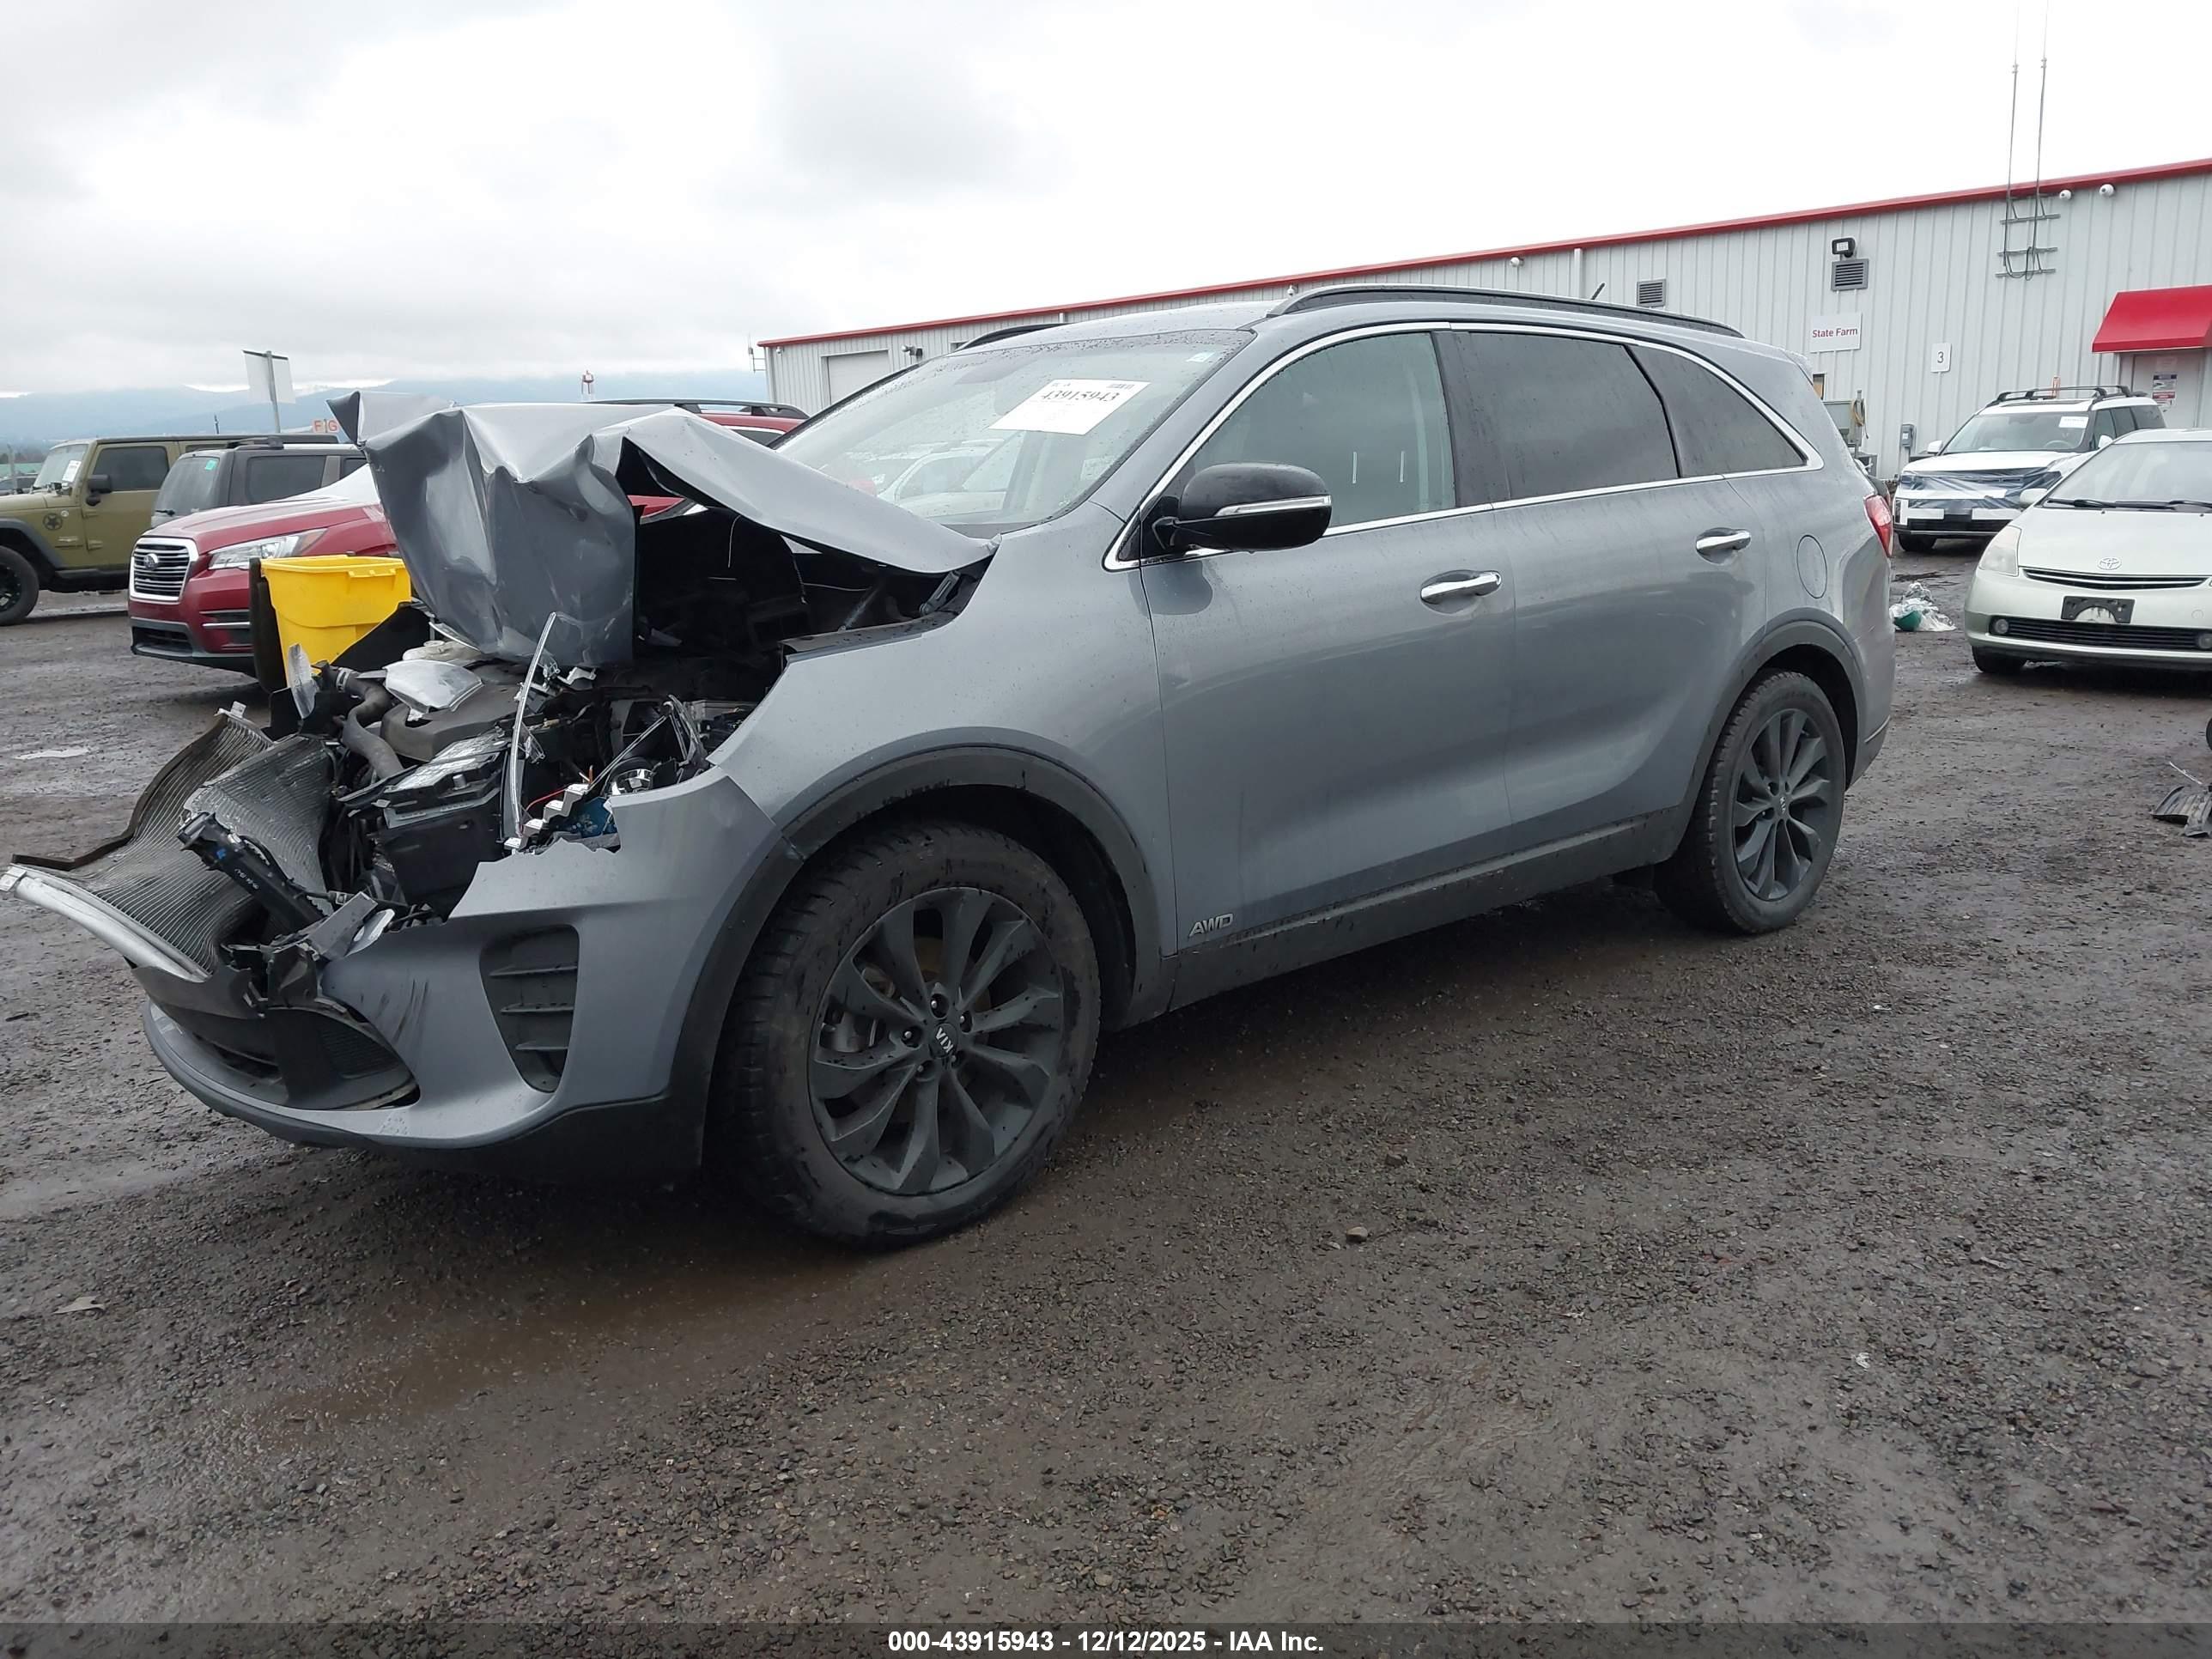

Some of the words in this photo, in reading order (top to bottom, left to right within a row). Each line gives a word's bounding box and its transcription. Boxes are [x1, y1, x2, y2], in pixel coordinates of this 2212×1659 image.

[1812, 329, 1834, 338] State
[1835, 327, 1858, 337] Farm
[1936, 350, 1945, 364] 3
[1041, 389, 1121, 402] 43915943
[1188, 913, 1234, 937] AWD
[935, 1026, 954, 1053] KIA
